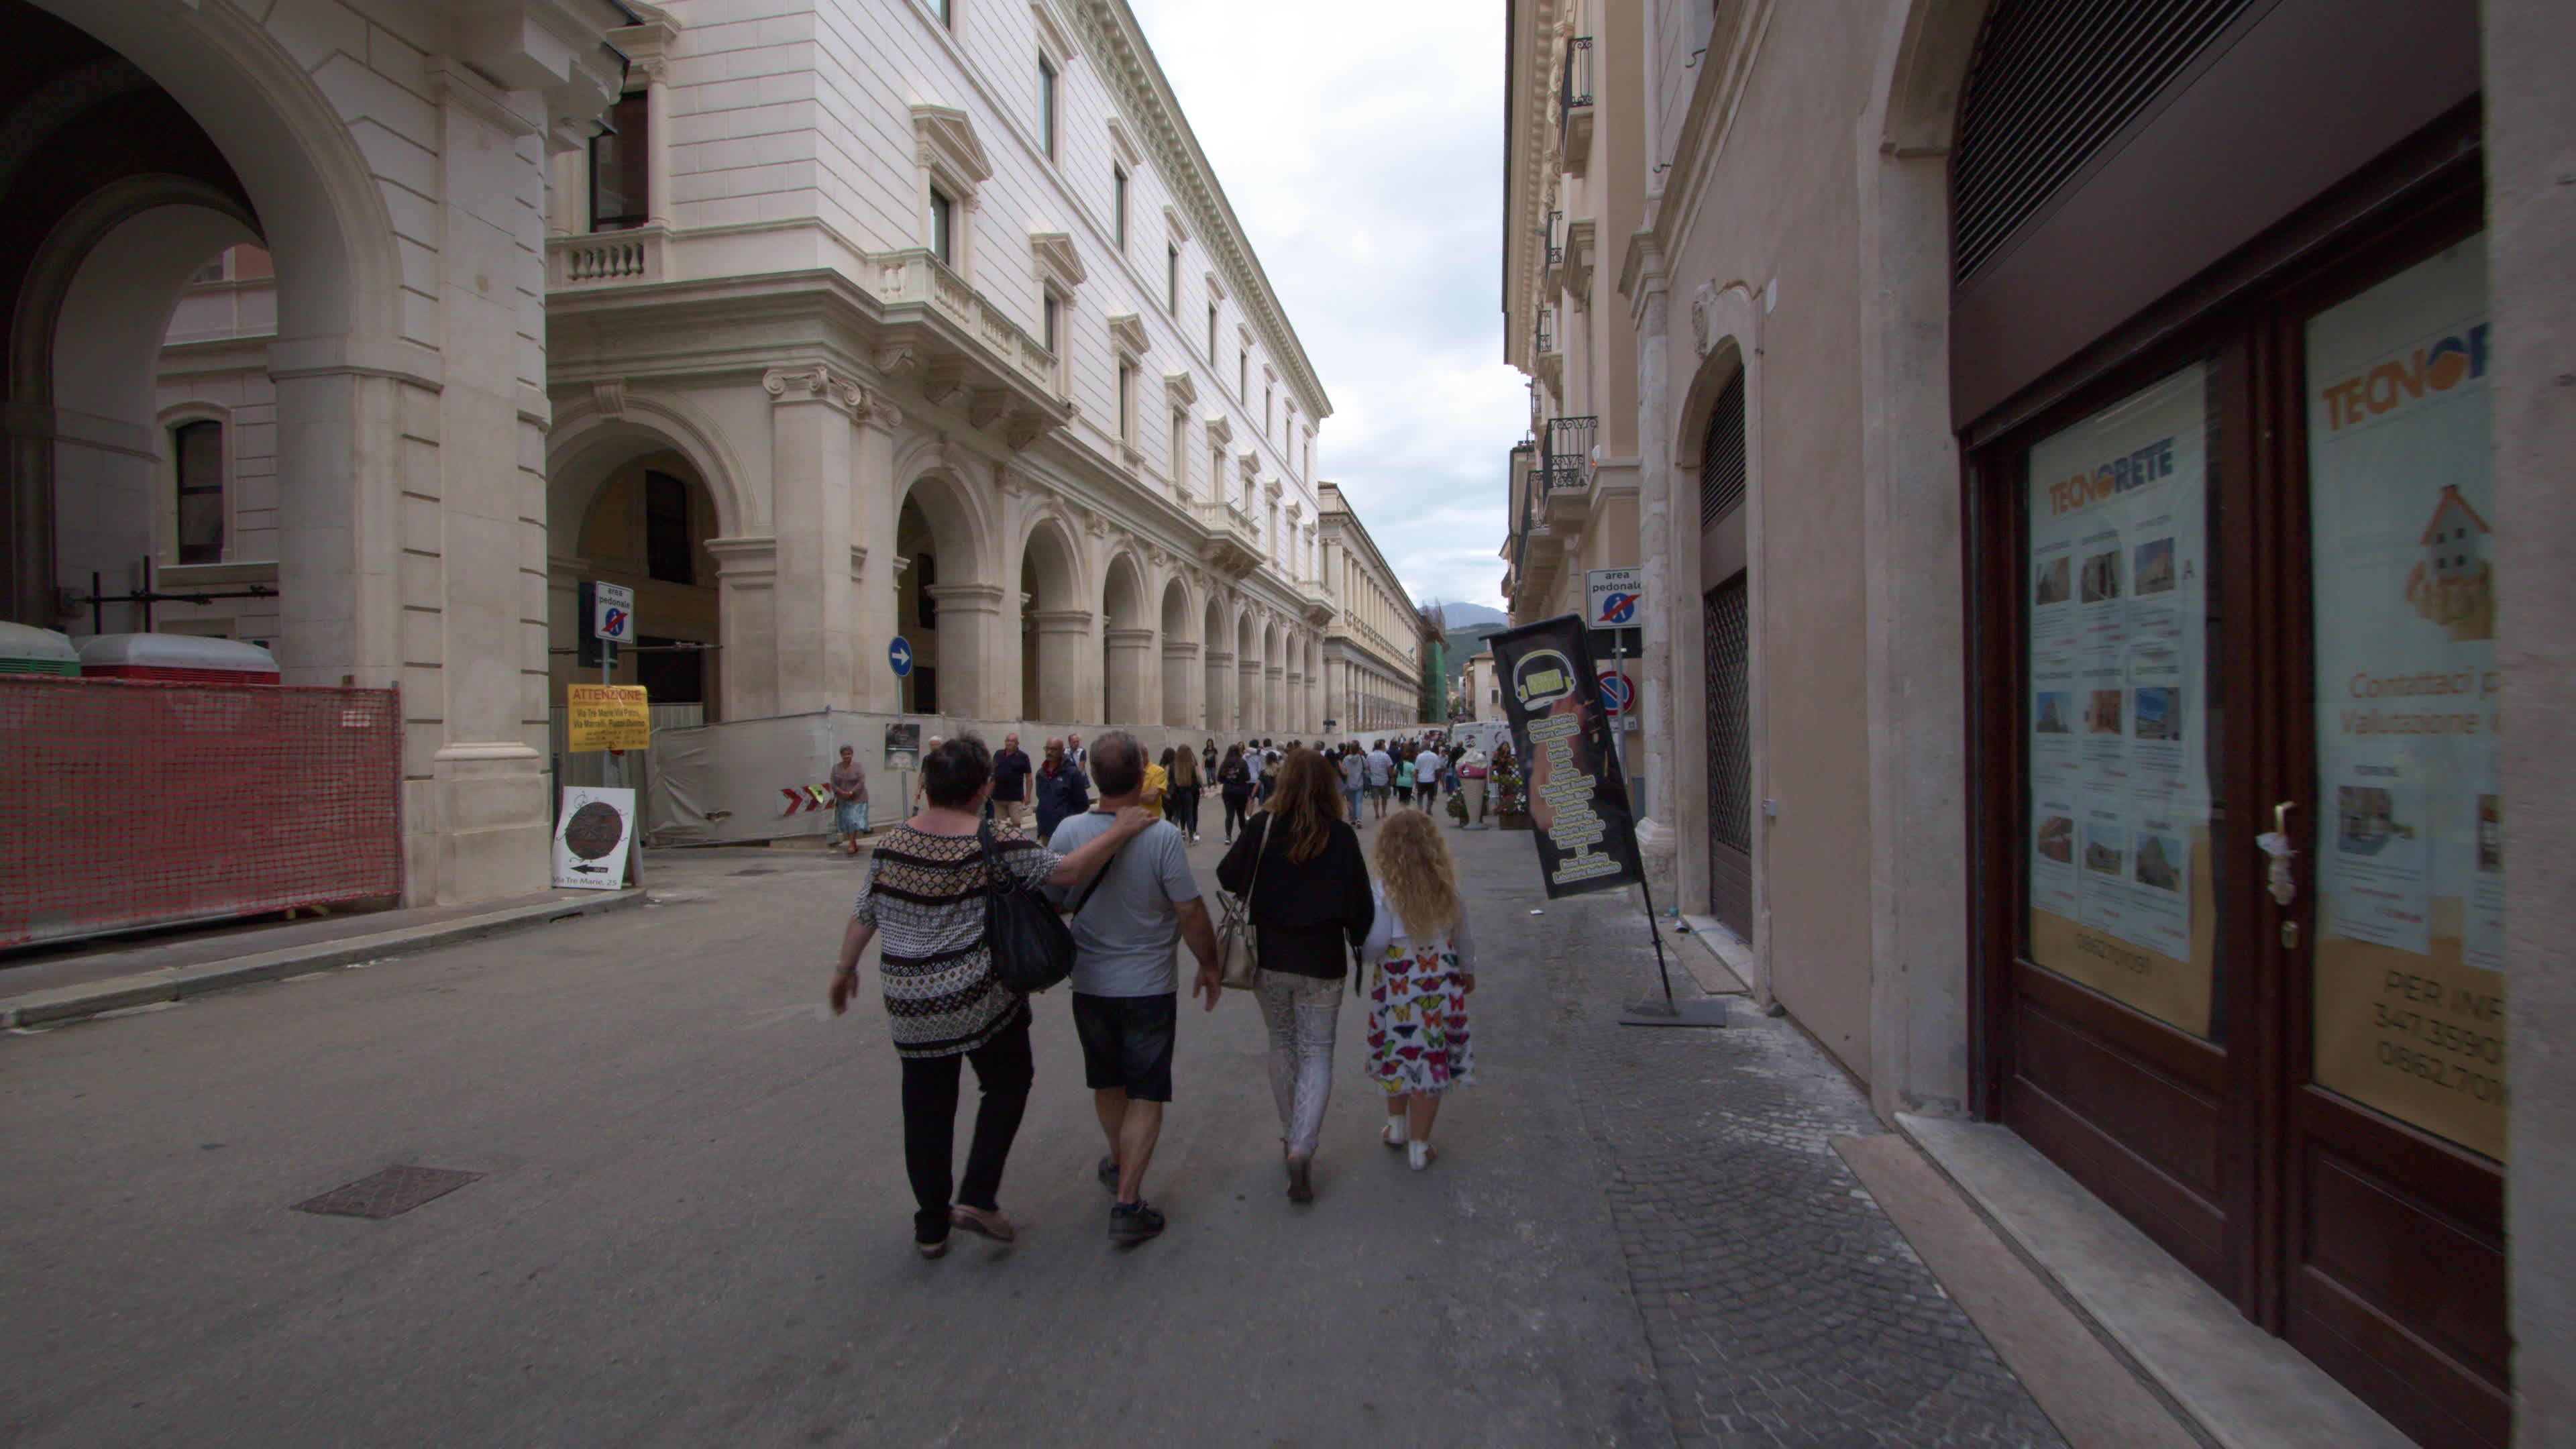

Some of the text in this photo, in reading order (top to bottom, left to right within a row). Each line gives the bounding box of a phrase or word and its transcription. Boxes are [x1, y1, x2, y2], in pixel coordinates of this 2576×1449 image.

[2049, 436, 2174, 516] TECNORETE
[1605, 572, 1629, 580] area
[607, 588, 623, 597] area
[598, 596, 631, 609] pedonale
[2350, 666, 2475, 698] Contattaci
[572, 688, 643, 701] ATTENZIONE
[2340, 708, 2479, 735] Valutazione
[553, 875, 564, 883] Via
[2385, 970, 2443, 1007] PER
